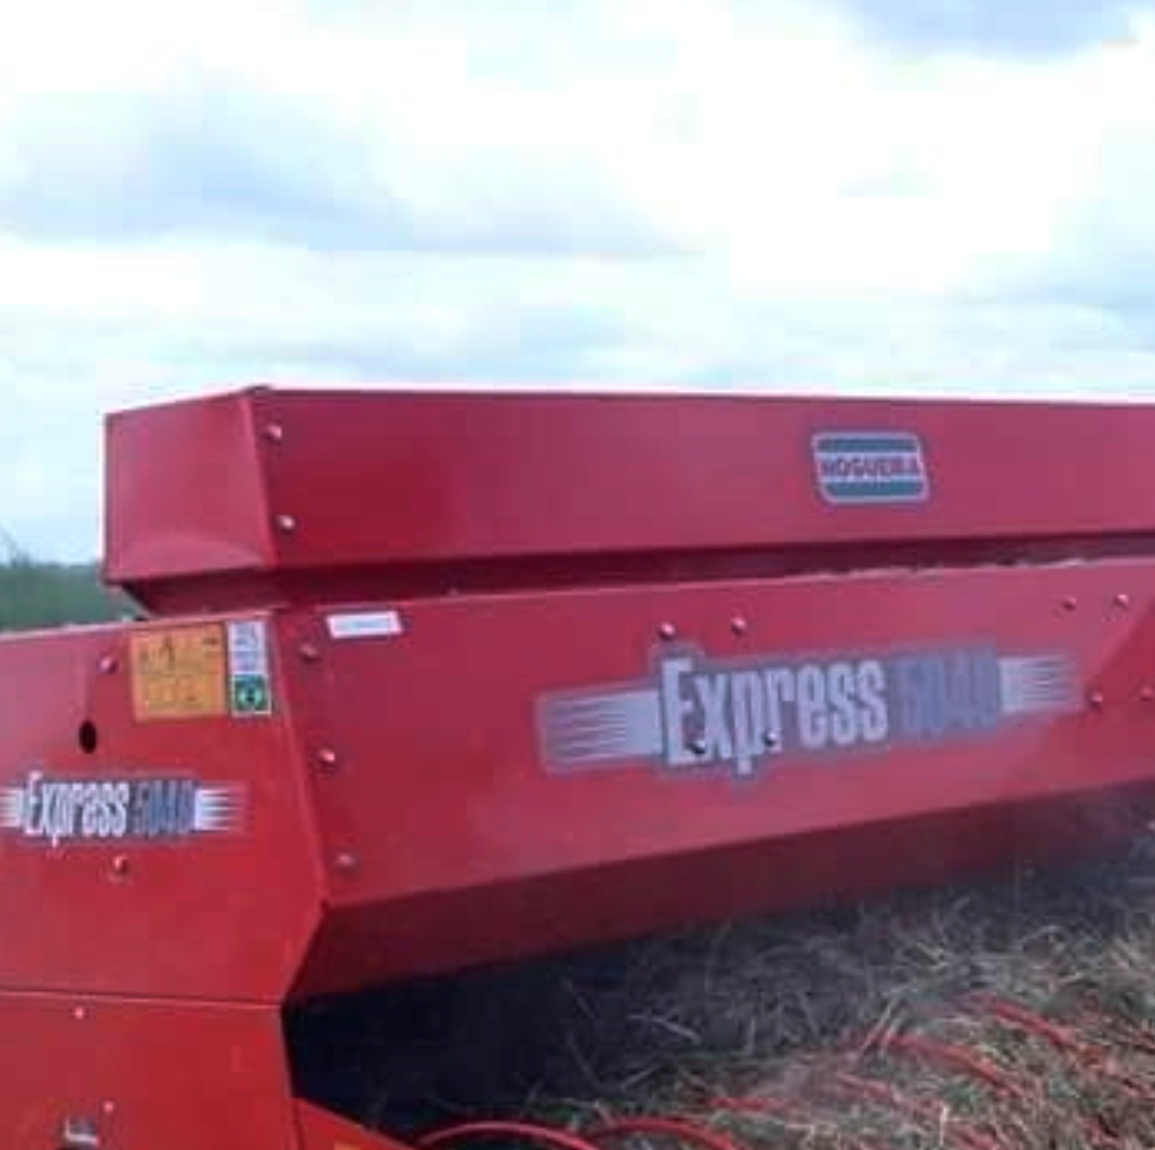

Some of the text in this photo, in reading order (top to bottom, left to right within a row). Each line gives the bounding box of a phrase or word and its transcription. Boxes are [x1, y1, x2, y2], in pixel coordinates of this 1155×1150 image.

[820, 457, 922, 479] NOGUEIRA
[660, 656, 887, 775] Express
[24, 771, 130, 847] Express
